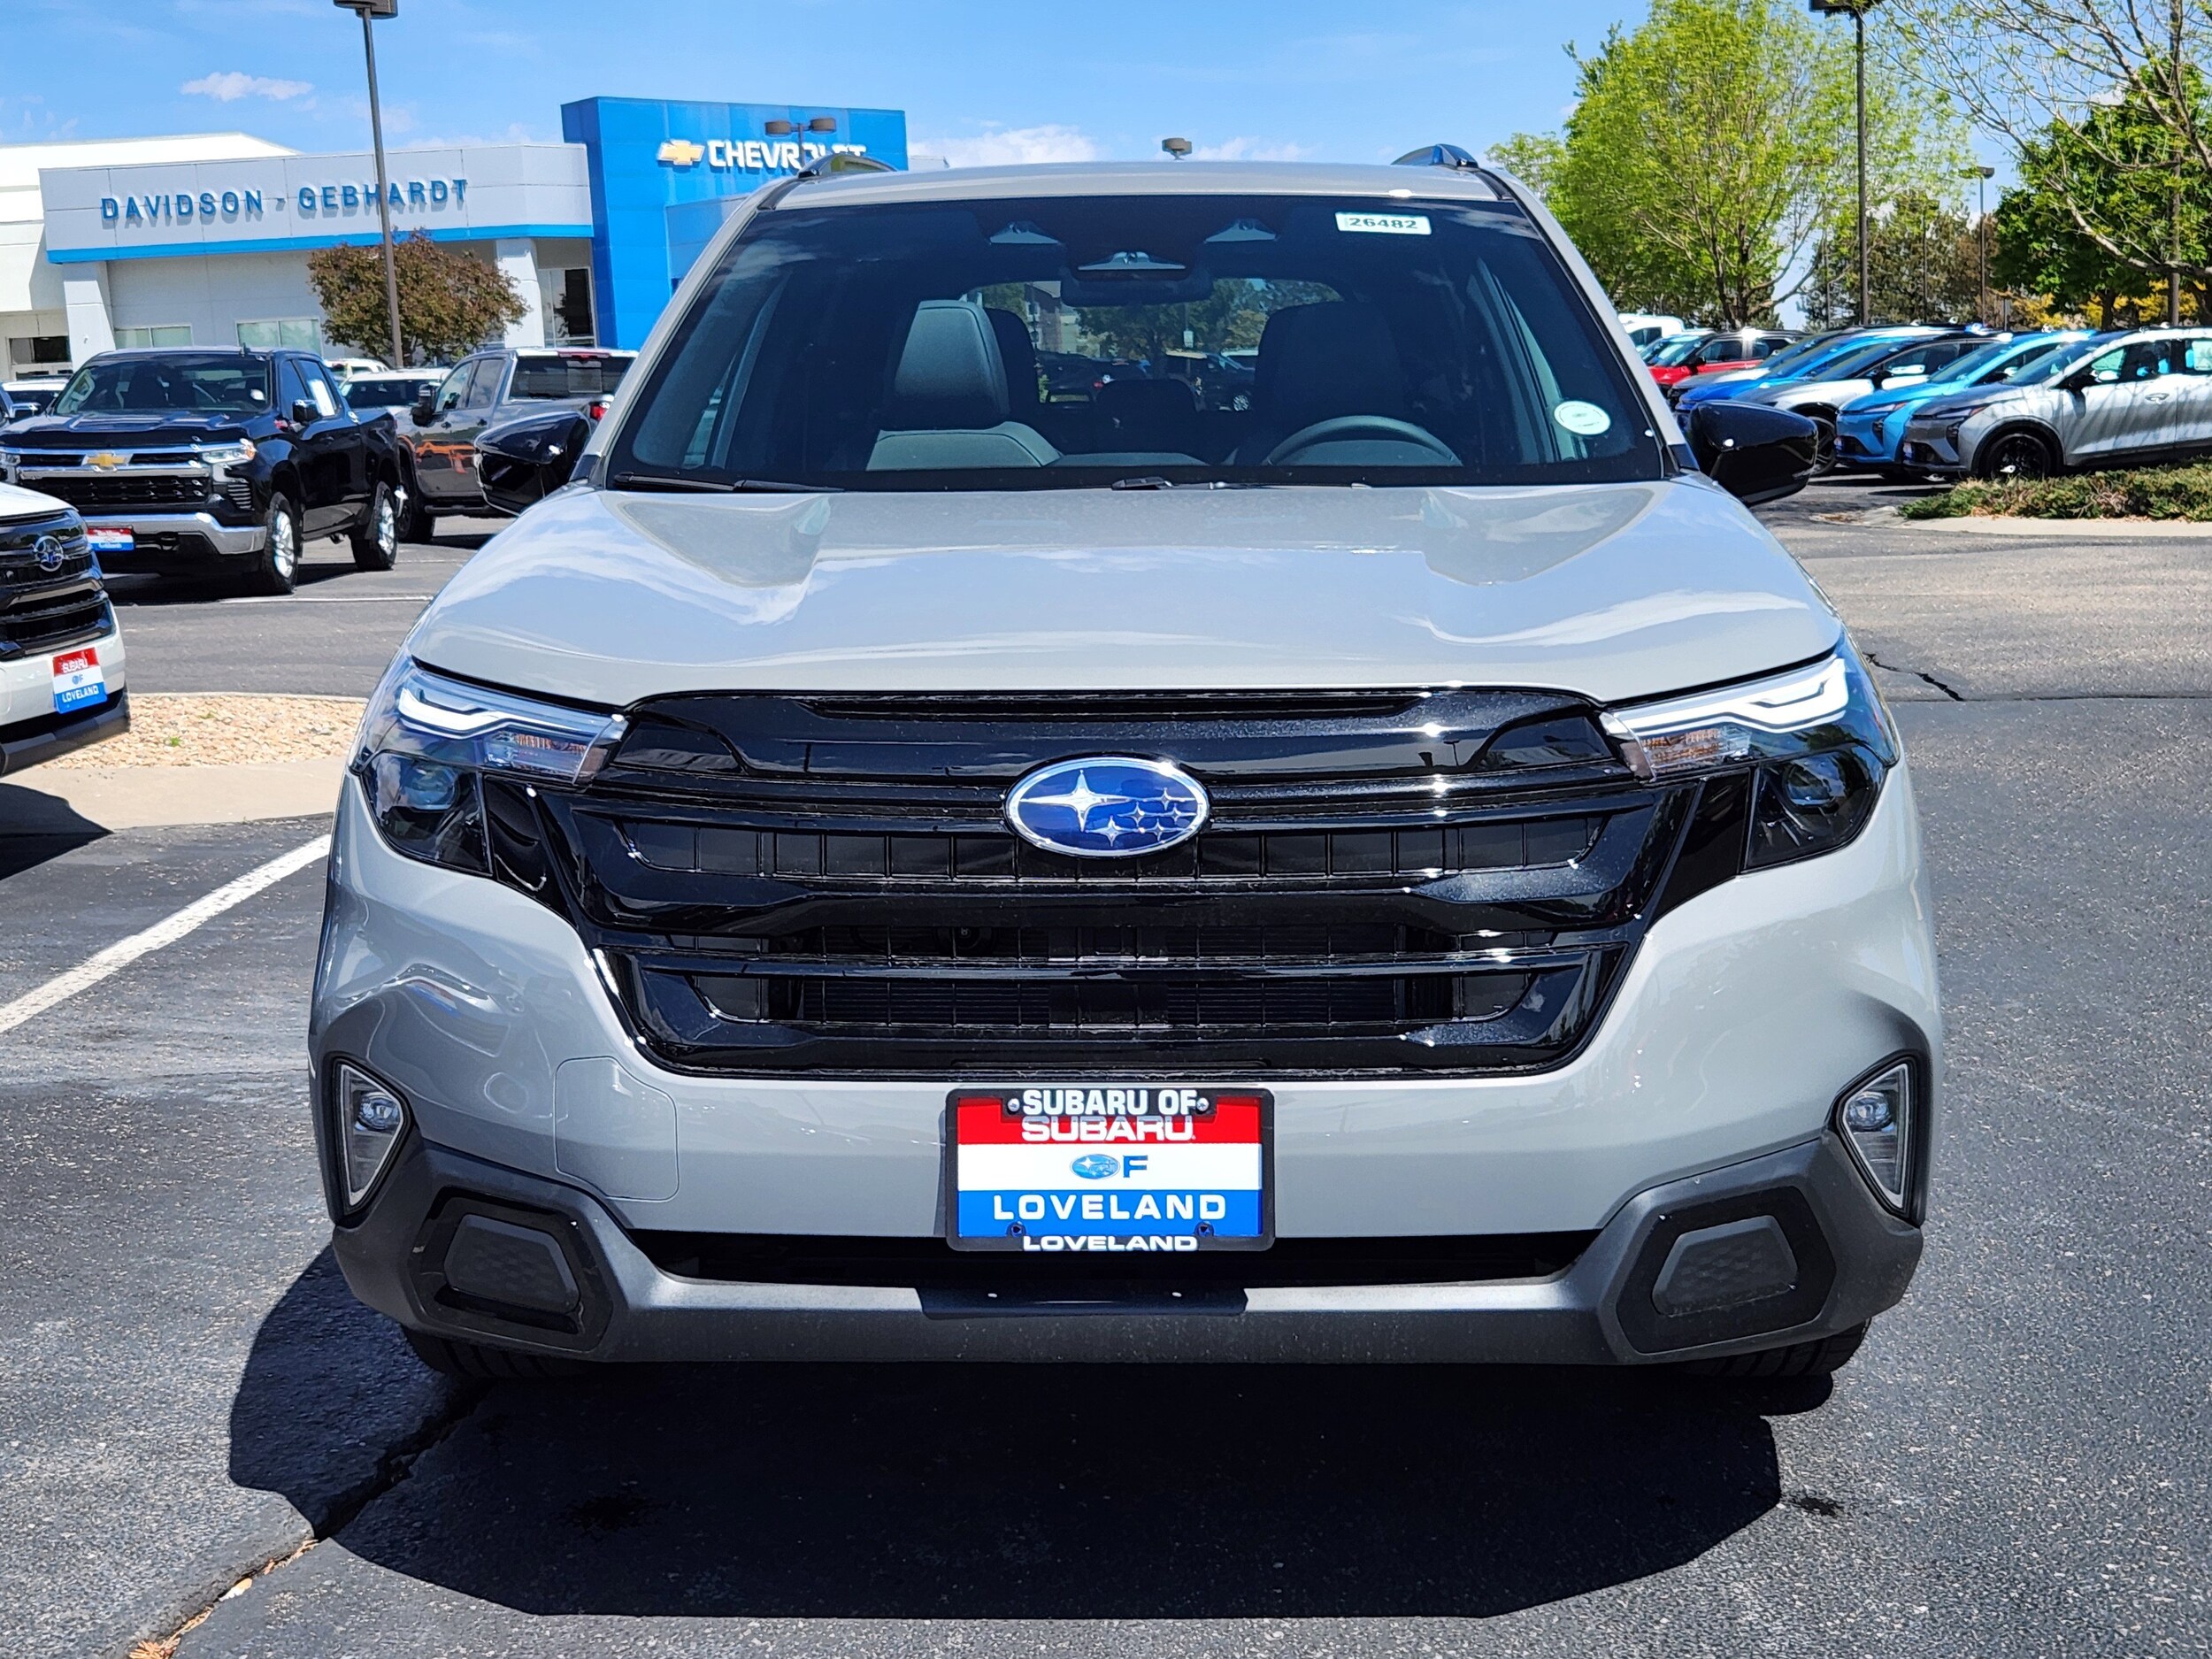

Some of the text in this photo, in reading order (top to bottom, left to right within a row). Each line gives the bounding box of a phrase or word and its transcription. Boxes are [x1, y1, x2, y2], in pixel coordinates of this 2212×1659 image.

[101, 189, 264, 220] DAVIDSON
[298, 179, 468, 211] GEBHARDT
[1348, 218, 1417, 229] 26482
[62, 685, 99, 703] LOVELAND
[1023, 1089, 1197, 1116] SUBARU OF
[1021, 1116, 1194, 1141] SUBARU
[993, 1194, 1226, 1220] LOVELAND
[1023, 1235, 1198, 1251] LOVELAND
